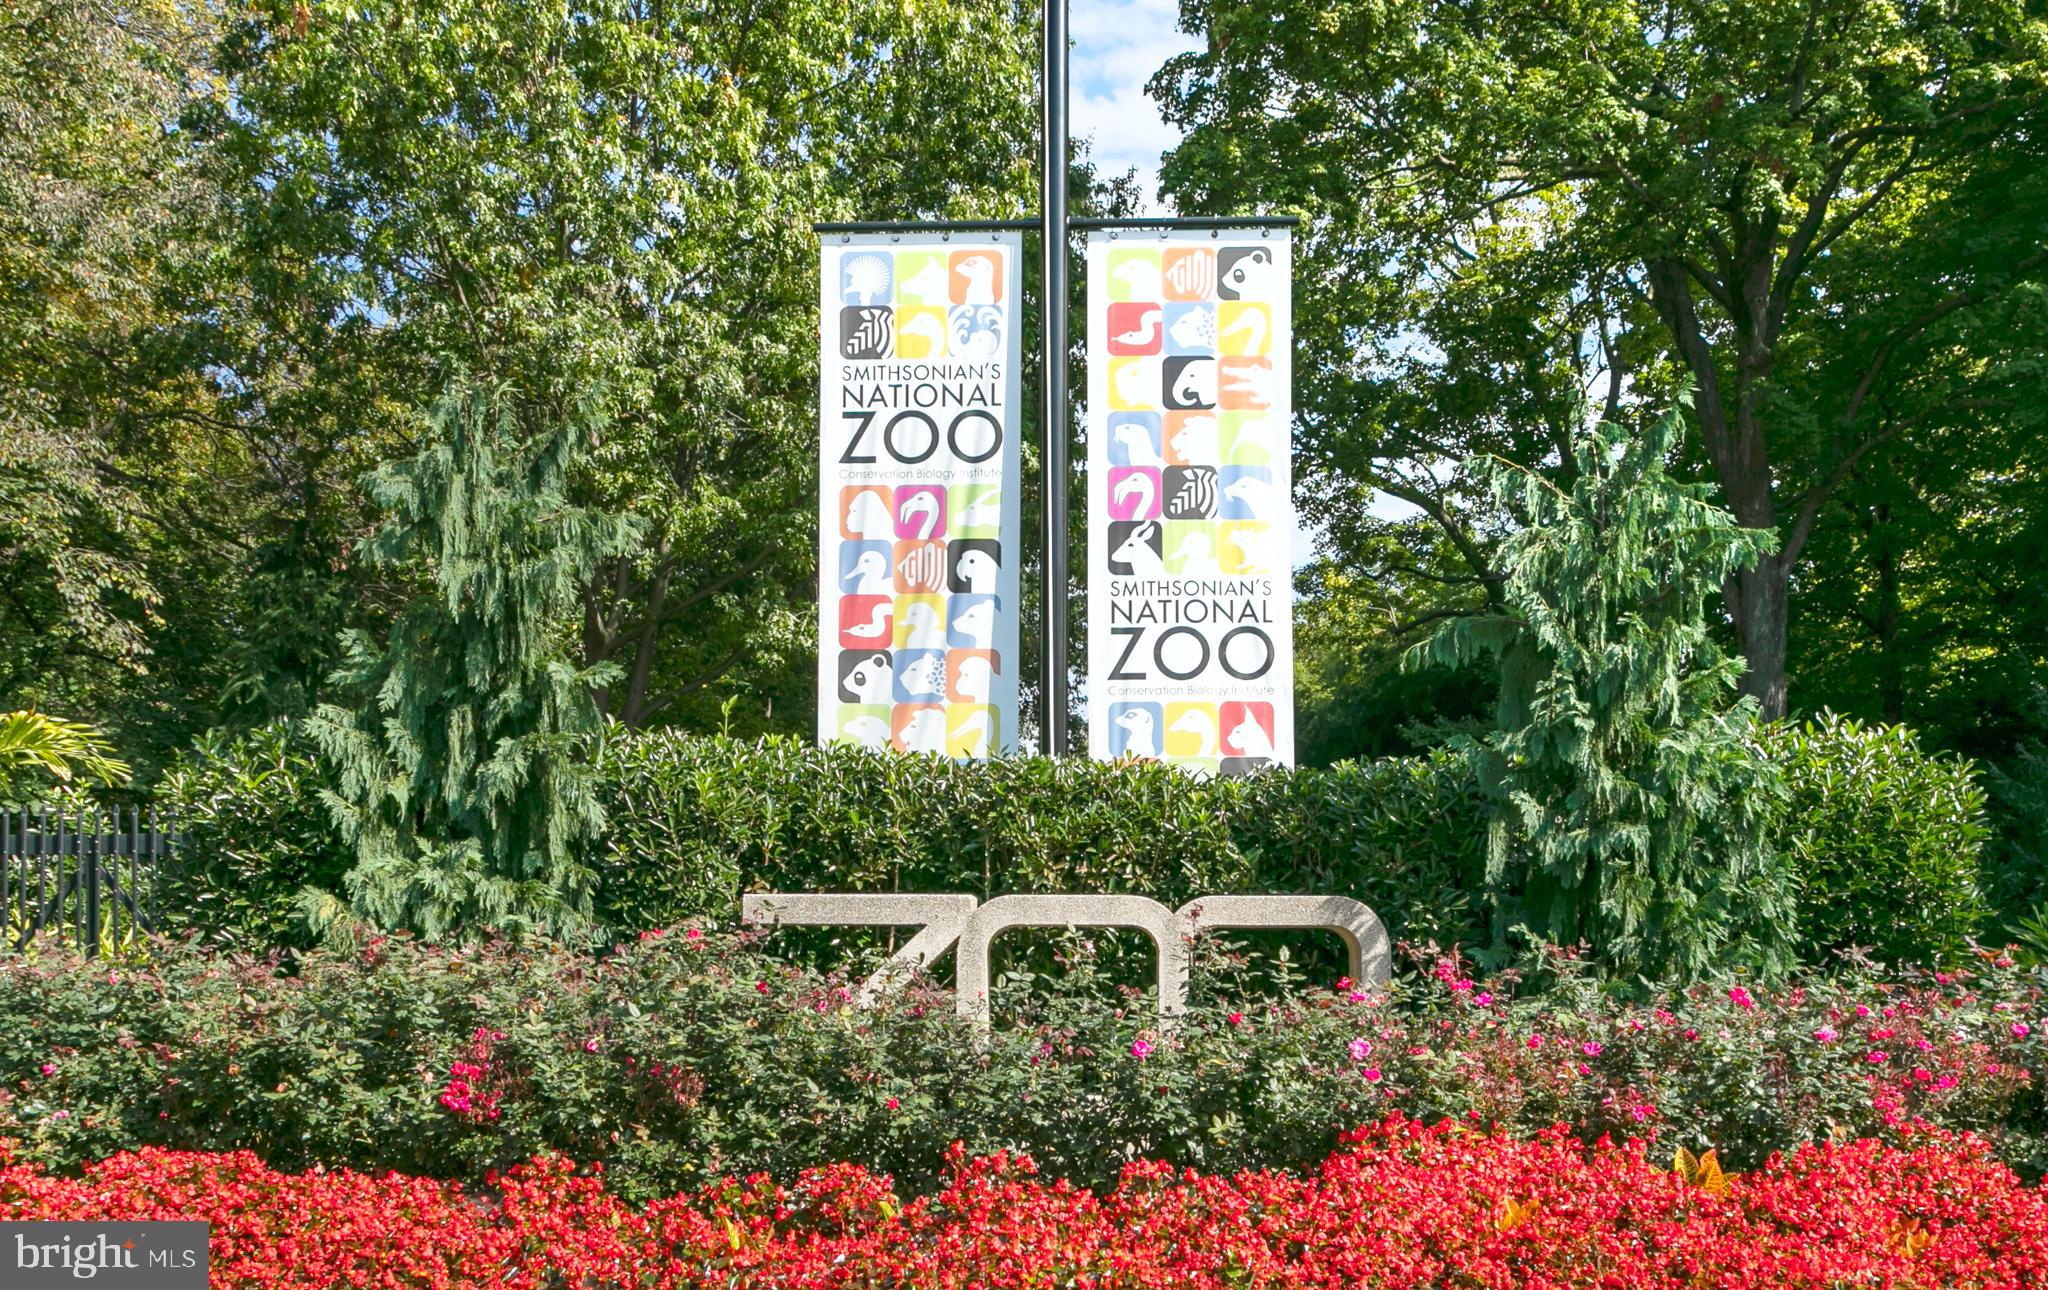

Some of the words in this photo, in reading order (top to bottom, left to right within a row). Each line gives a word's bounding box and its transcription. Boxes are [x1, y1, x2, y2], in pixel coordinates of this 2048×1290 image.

[842, 363, 1001, 381] SMITHSONIAN'S
[842, 383, 1002, 408] NATIONAL
[838, 409, 1003, 465] ZOO
[838, 469, 913, 480] Conservation
[916, 469, 957, 482] Biology
[959, 467, 1002, 479] Institute
[1110, 578, 1272, 597] SMITHSONIAN'S
[1110, 599, 1273, 624] NATIONAL
[1107, 625, 1275, 681] ZOO
[1107, 685, 1184, 696] Conservation
[1187, 685, 1229, 698] Biology
[1231, 686, 1275, 696] Intitute
